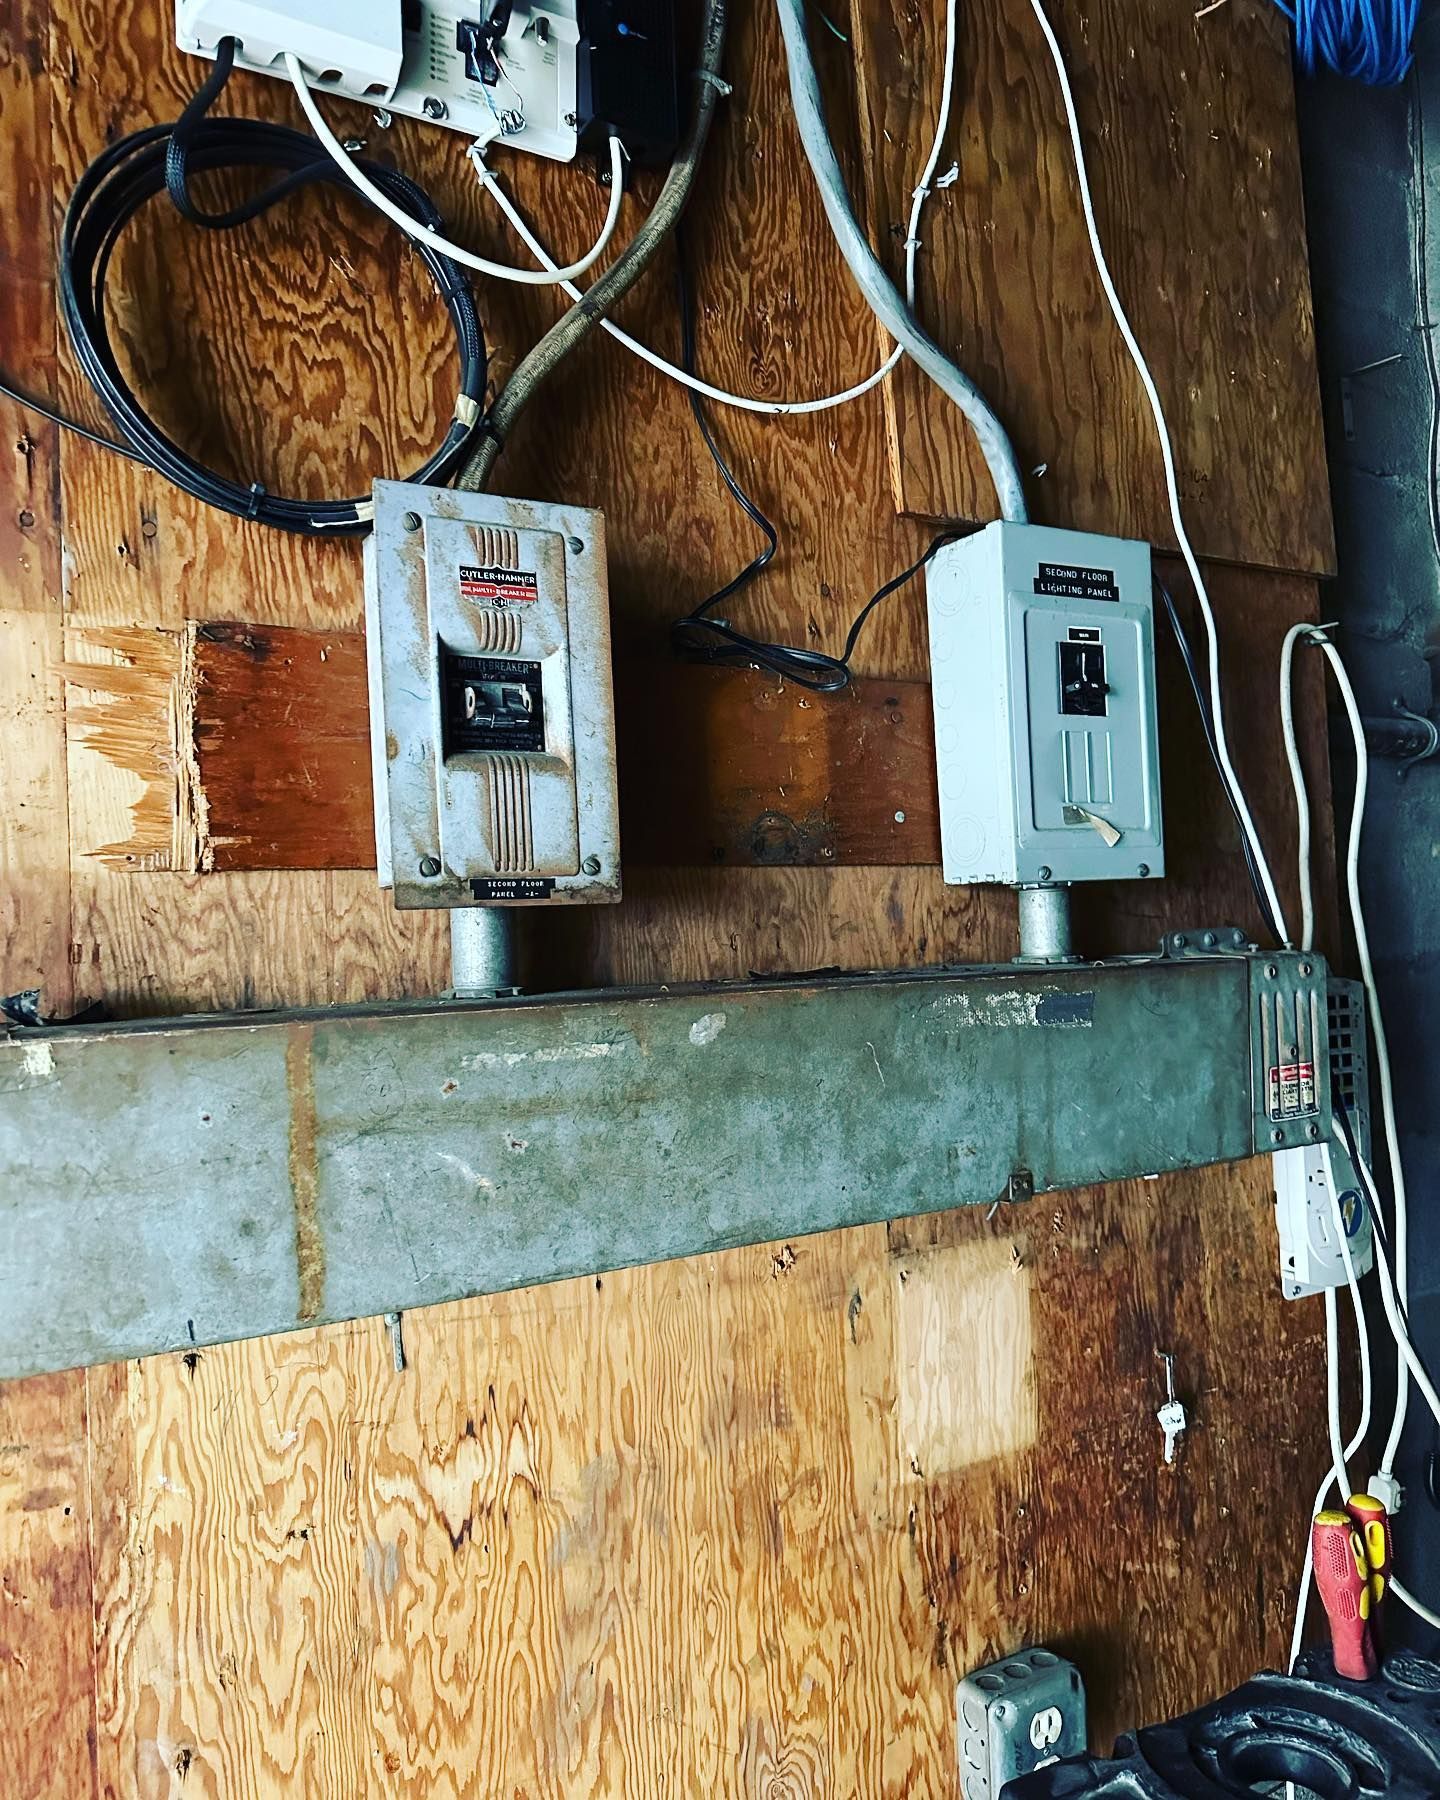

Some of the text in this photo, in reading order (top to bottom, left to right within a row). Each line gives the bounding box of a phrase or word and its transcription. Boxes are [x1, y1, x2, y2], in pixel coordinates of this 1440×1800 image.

[1045, 567, 1108, 582] SECOND FLOOR
[1040, 583, 1112, 598] LIGHTING PANEL
